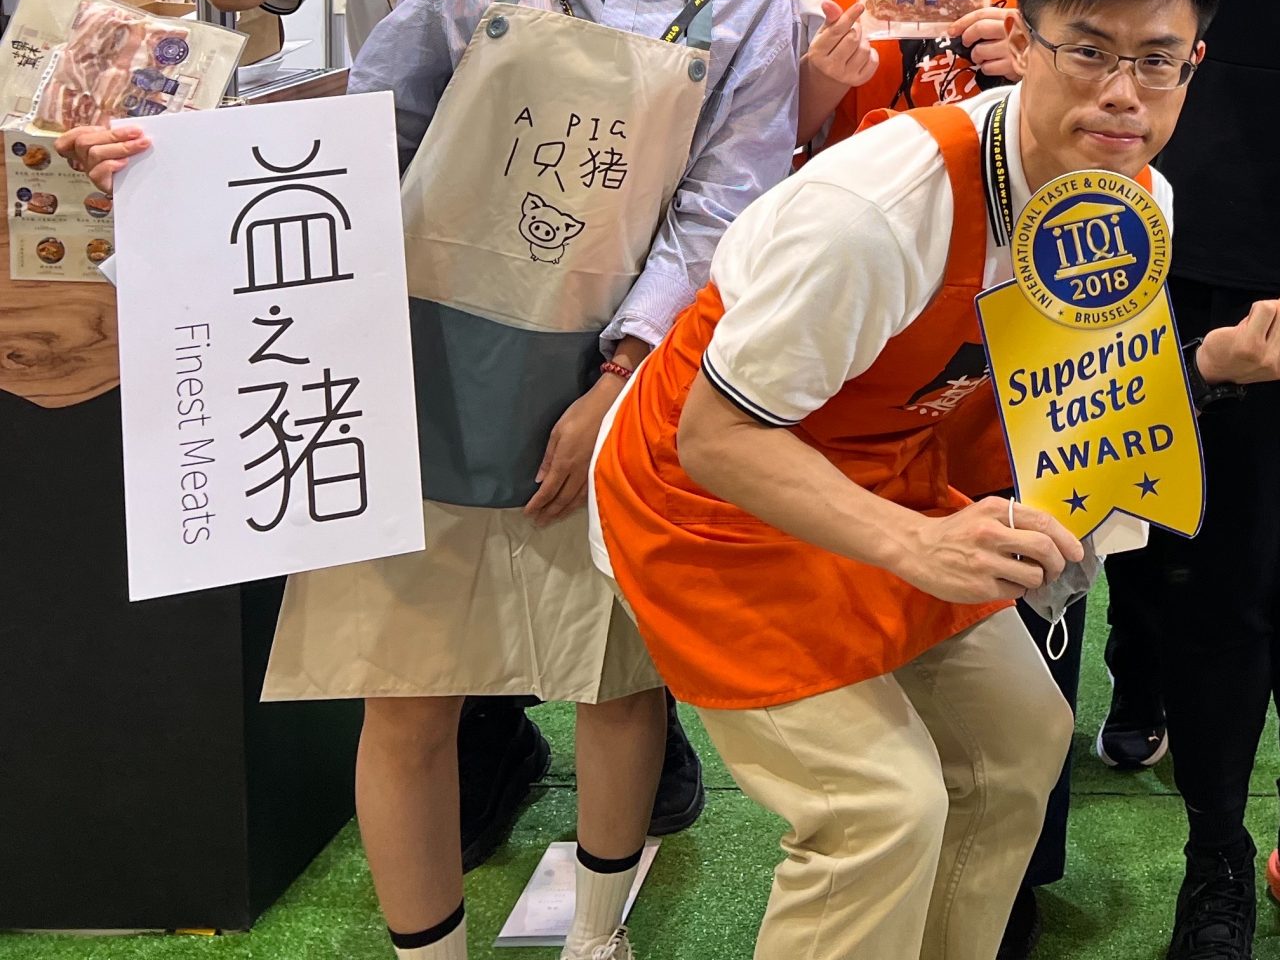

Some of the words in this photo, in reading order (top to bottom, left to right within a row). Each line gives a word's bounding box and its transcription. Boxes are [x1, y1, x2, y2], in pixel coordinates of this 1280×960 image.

[514, 106, 533, 128] A
[567, 113, 627, 141] PIG
[1017, 207, 1053, 310] INTERNATIONAL
[1039, 178, 1079, 206] TASTE
[1083, 177, 1093, 188] &
[1098, 177, 1152, 213] QUALITY
[1147, 214, 1166, 284] INSTITUTE
[1069, 269, 1129, 301] 2018
[1075, 299, 1139, 324] BRUSSELS
[174, 322, 213, 431] Finest
[1008, 324, 1168, 407] Superior
[1045, 375, 1147, 433] taste
[1035, 424, 1175, 480] AWARD
[178, 437, 217, 545] Meats
